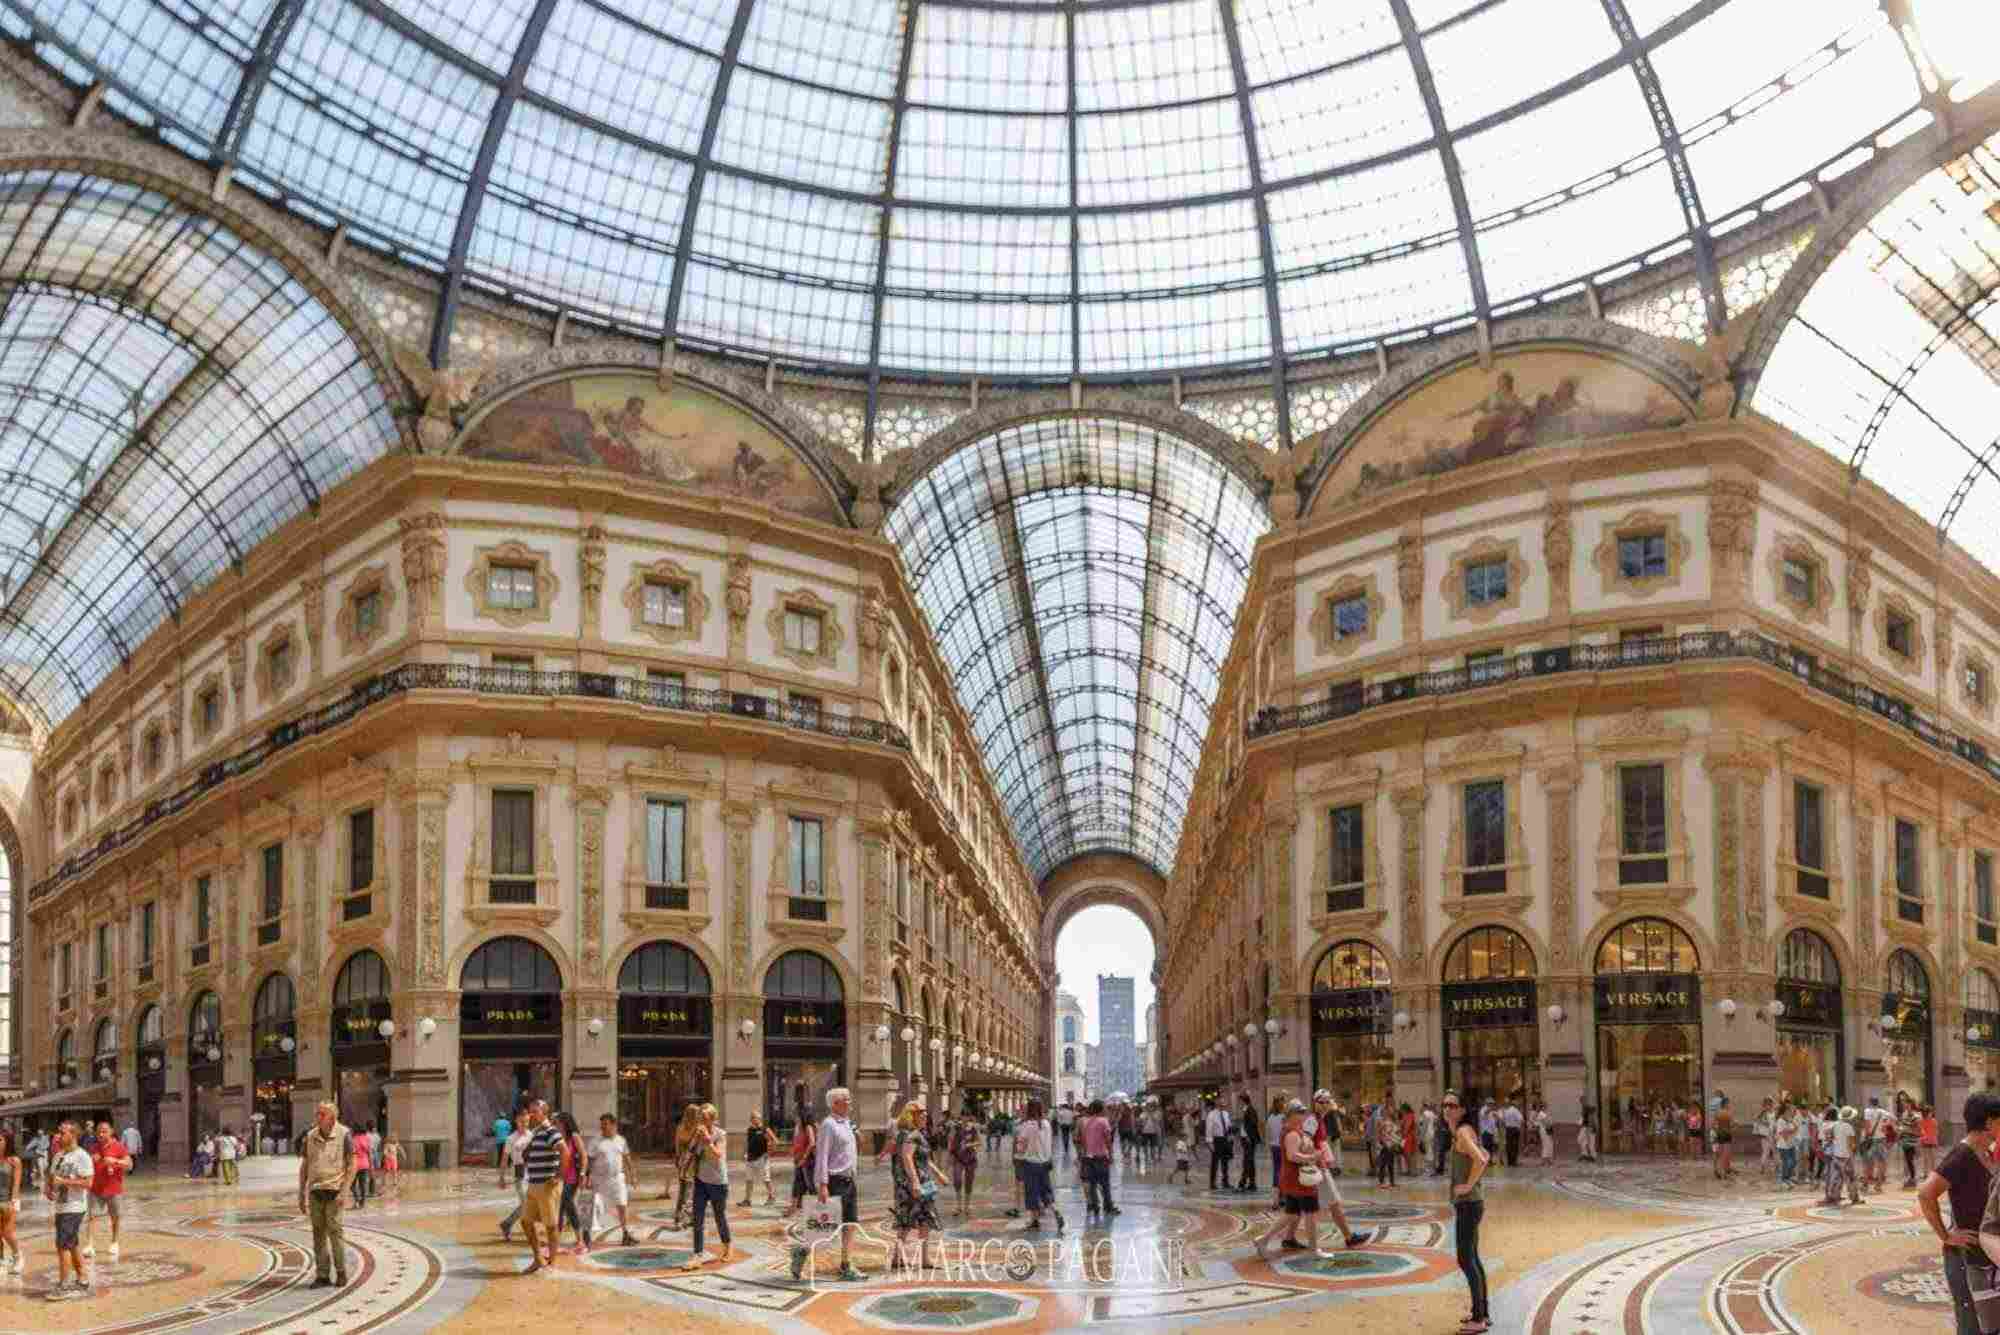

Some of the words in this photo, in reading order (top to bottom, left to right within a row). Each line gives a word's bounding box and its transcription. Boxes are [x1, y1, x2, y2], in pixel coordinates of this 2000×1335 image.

[1452, 995, 1528, 1012] VERSACE
[1606, 991, 1689, 1007] VERSACE
[486, 1009, 535, 1022] PRADA
